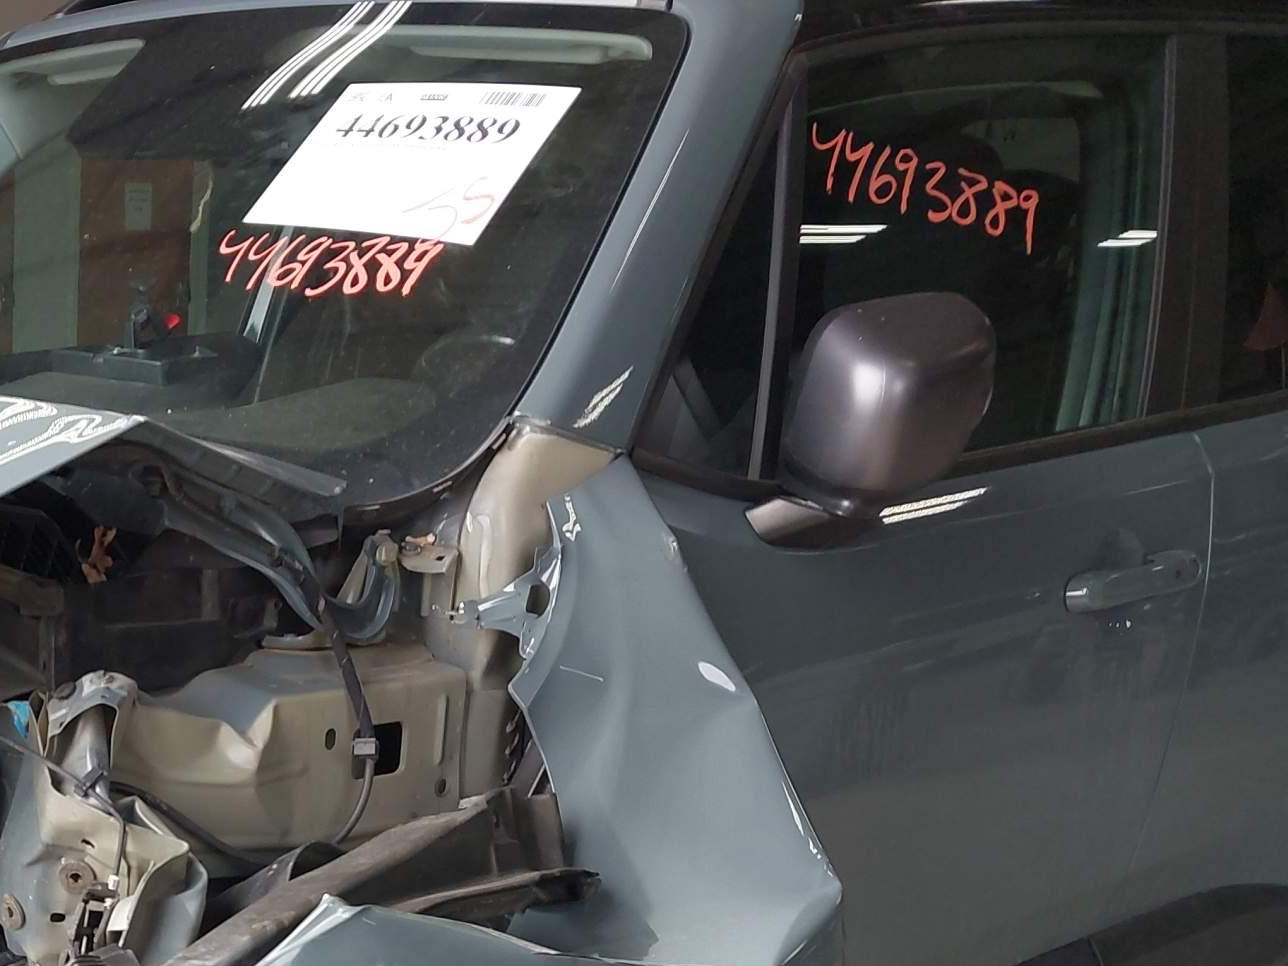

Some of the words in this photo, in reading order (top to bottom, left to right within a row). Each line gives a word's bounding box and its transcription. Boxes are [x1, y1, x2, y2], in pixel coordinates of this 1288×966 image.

[336, 113, 521, 144] 44693889
[811, 121, 1040, 256] 44693889
[219, 229, 445, 298] 44693889
